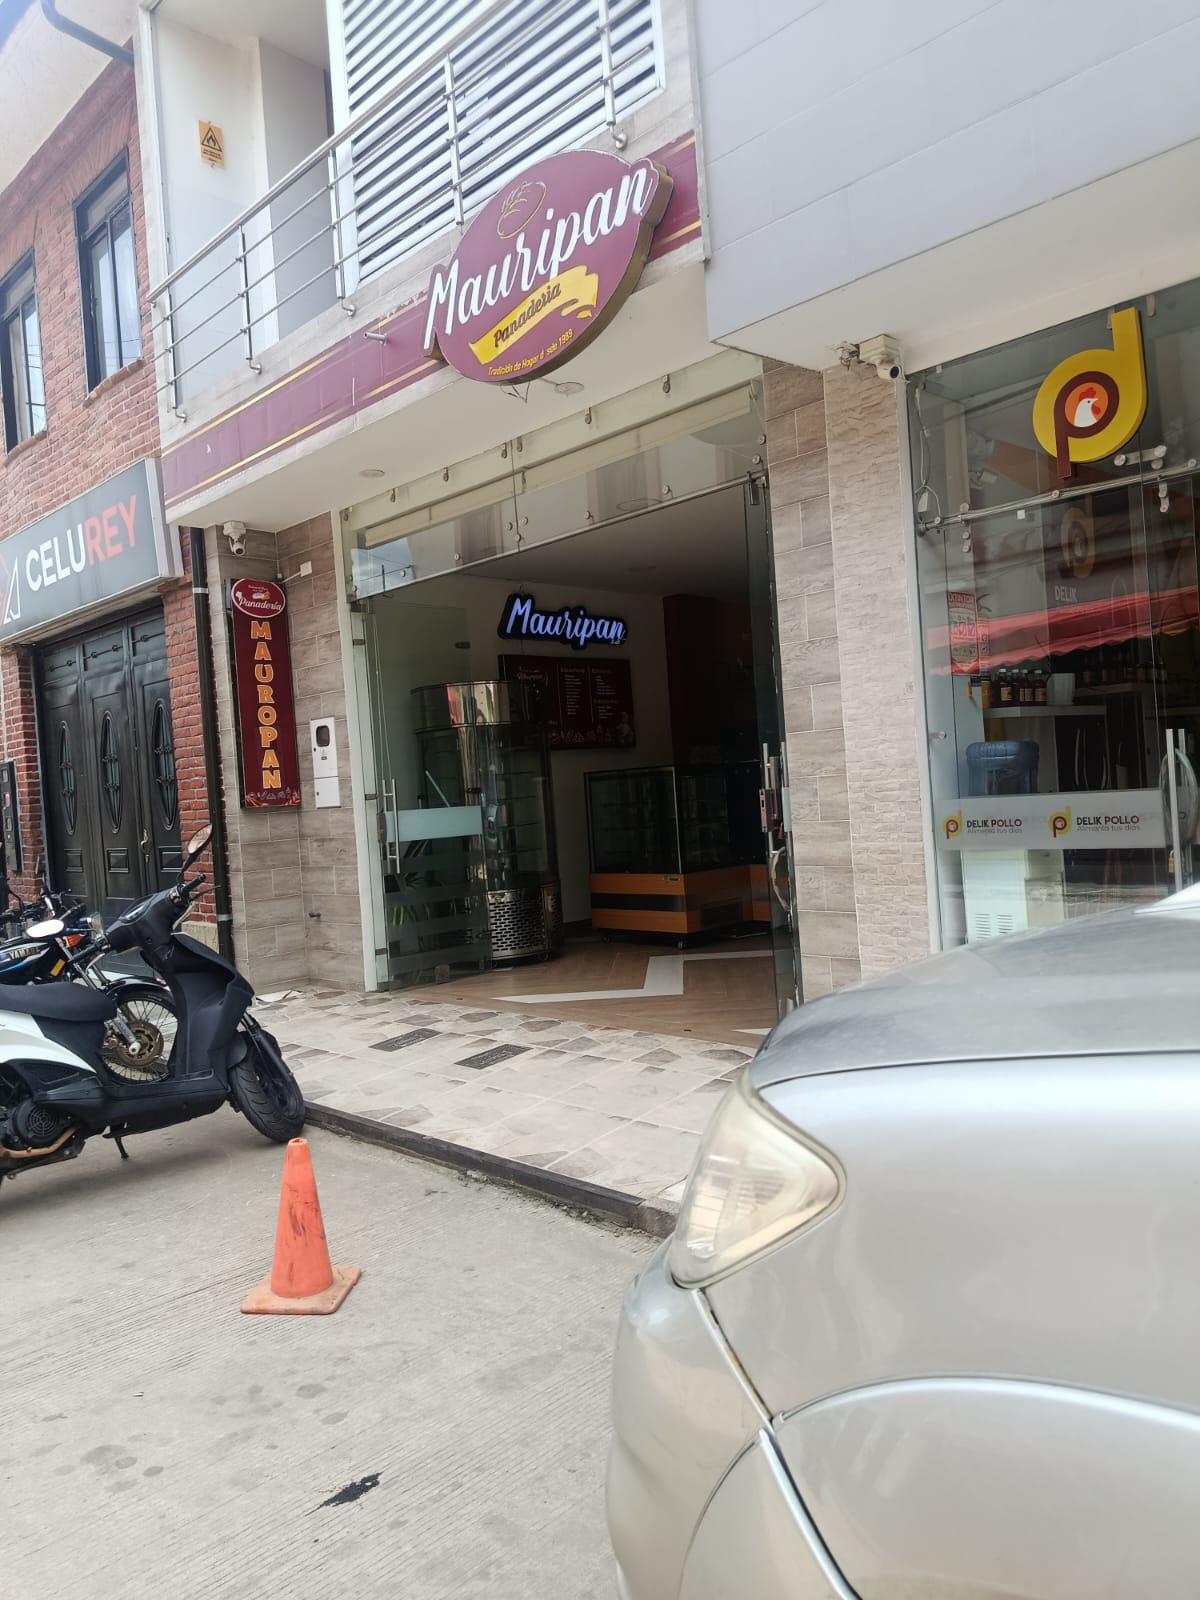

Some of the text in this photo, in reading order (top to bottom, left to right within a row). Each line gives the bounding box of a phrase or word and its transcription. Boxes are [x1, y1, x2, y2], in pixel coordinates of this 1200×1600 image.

[423, 167, 653, 350] Mauripan
[513, 360, 522, 371] de
[521, 354, 540, 368] Hogar
[558, 328, 574, 347] 1989
[25, 494, 138, 592] CELUREY
[1054, 585, 1078, 603] DELIK
[505, 597, 626, 646] Mauripan
[250, 620, 282, 789] MAUROPAN
[966, 818, 1023, 828] DELIK POLLO
[1076, 815, 1140, 826] DELIK POLLO
